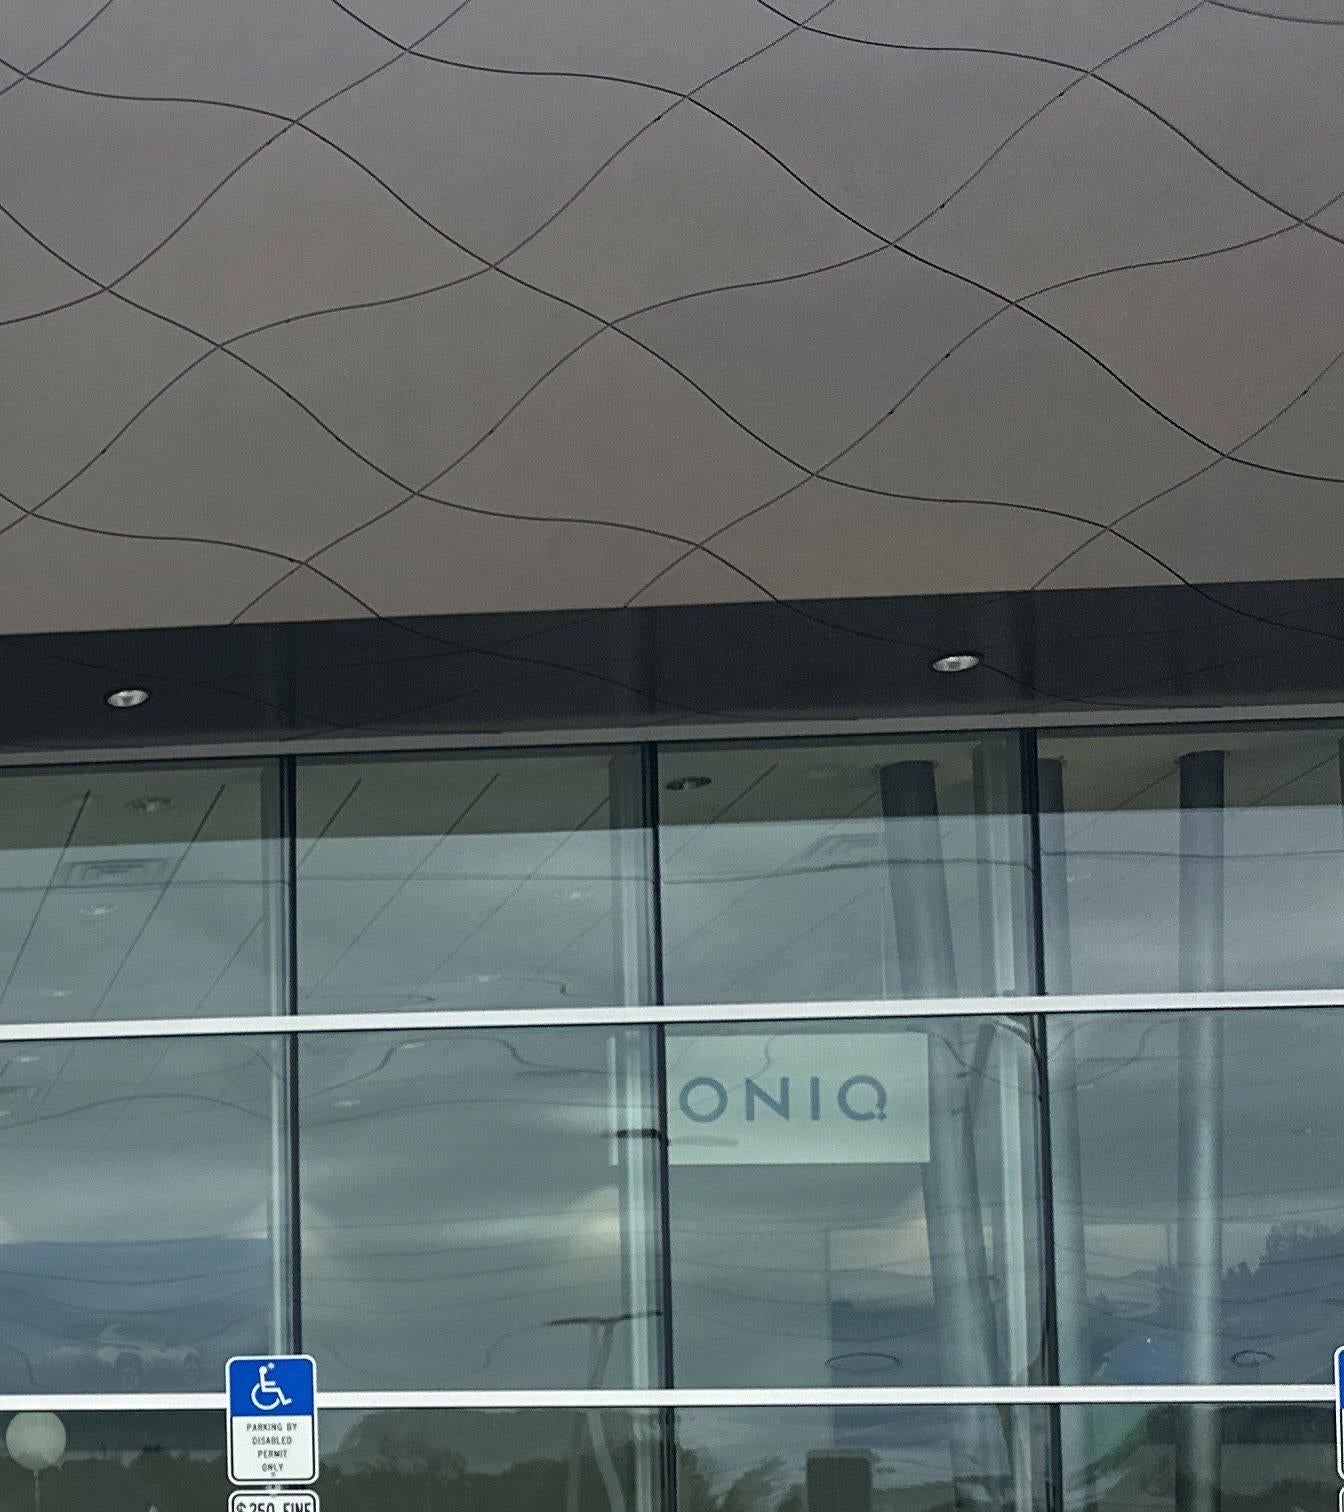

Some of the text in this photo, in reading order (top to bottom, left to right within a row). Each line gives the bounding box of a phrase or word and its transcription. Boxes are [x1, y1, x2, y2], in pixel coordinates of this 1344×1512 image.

[679, 1075, 887, 1123] ONIQ
[246, 1423, 297, 1431] PARKING BY
[252, 1437, 292, 1445] DISABLED
[258, 1450, 287, 1458] PERMIT
[262, 1463, 284, 1472] ONLY
